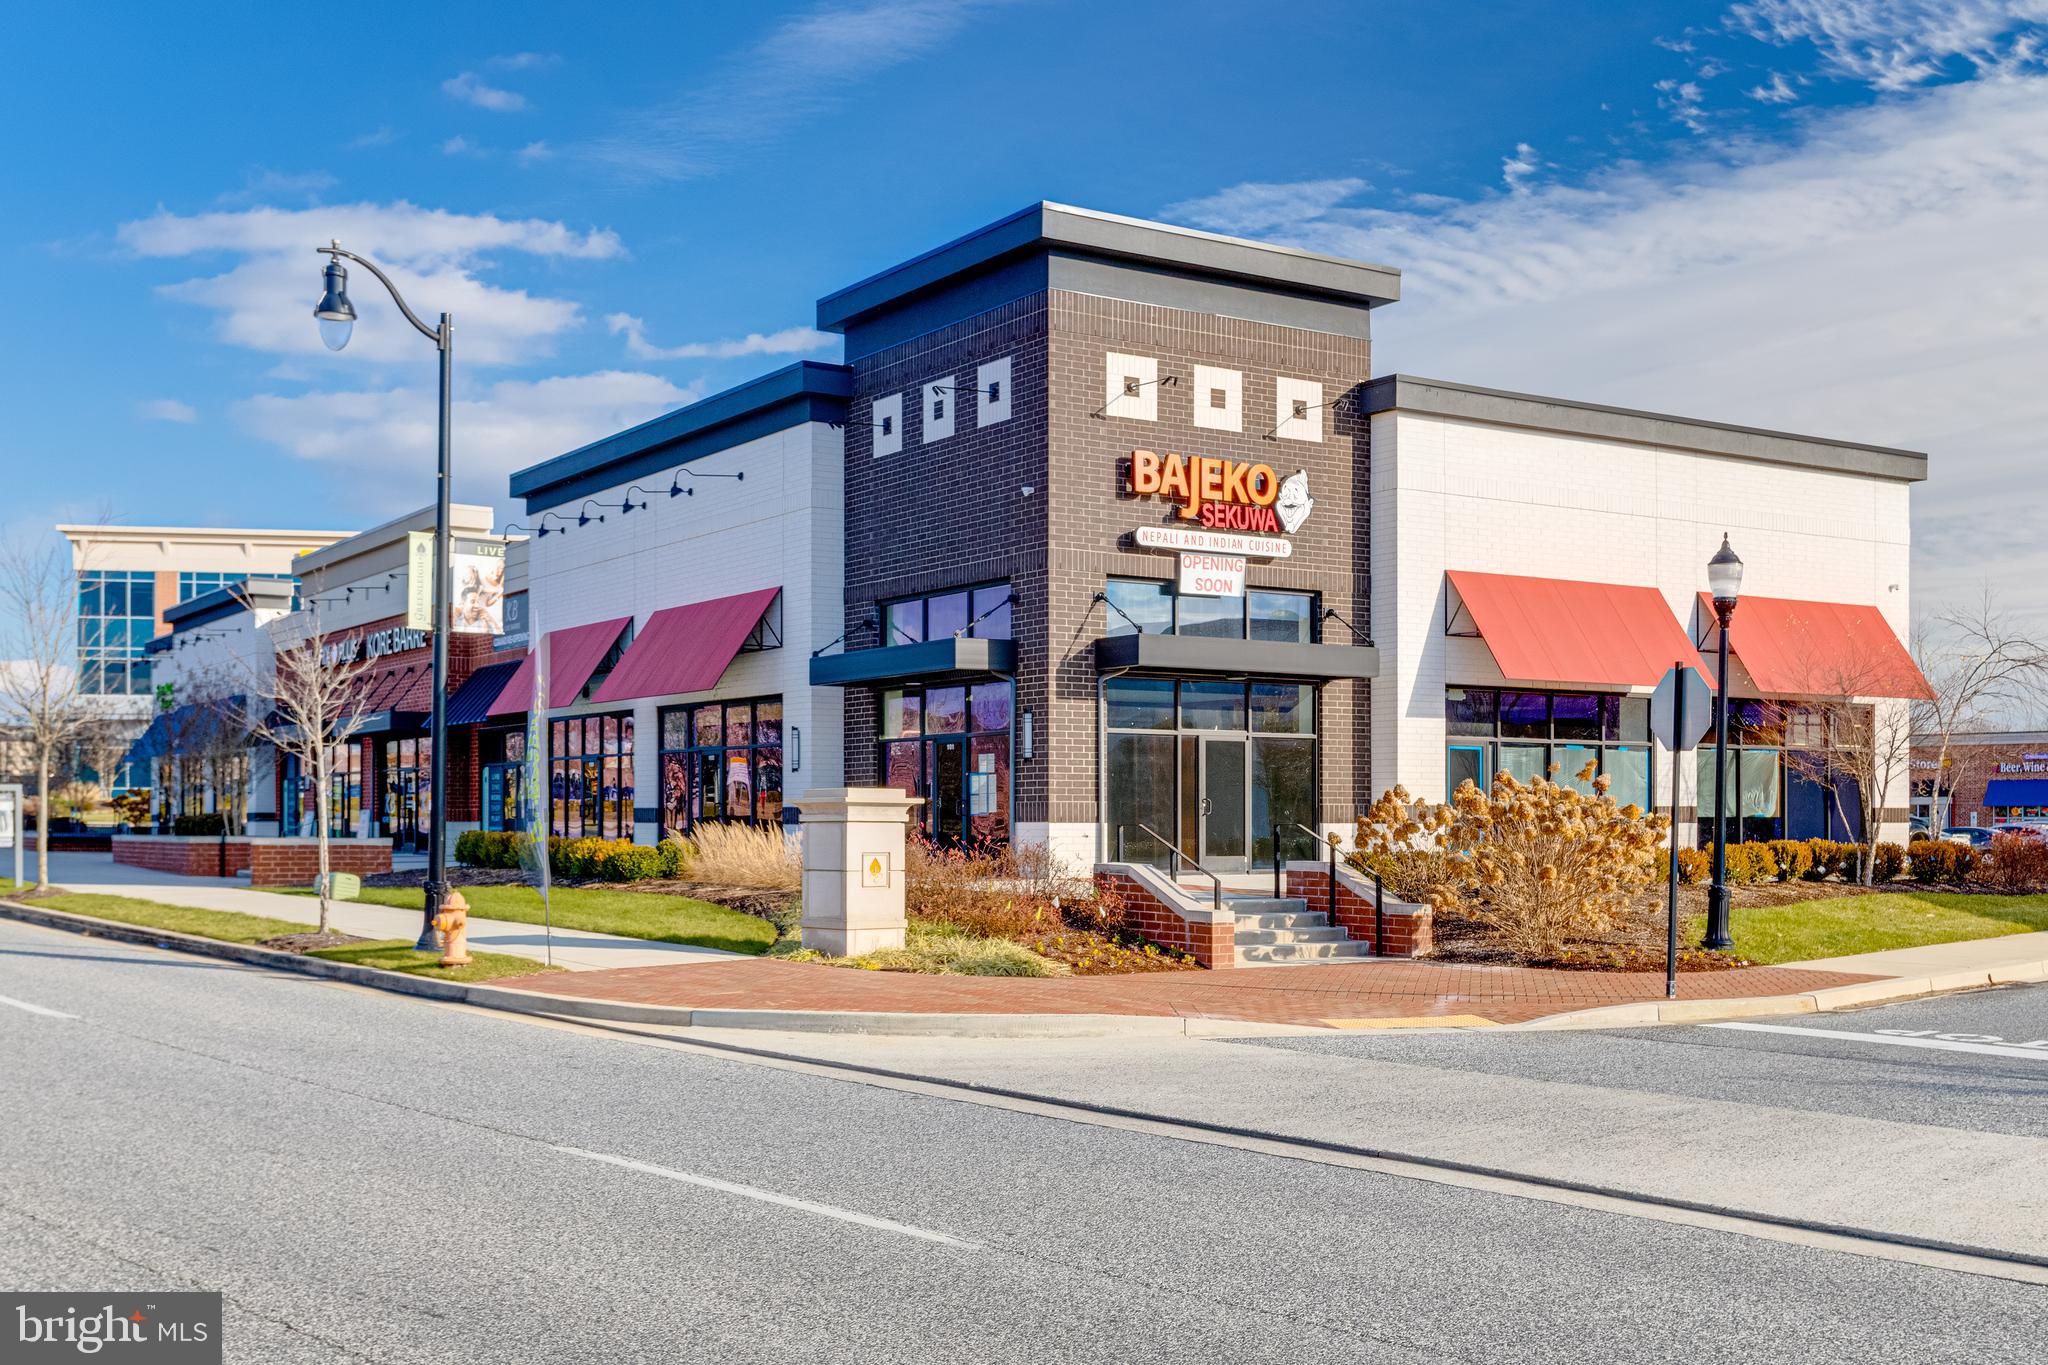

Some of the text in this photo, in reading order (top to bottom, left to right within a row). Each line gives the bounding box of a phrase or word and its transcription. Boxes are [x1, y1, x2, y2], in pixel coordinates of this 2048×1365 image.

[1132, 450, 1277, 518] BAJEKO
[1202, 504, 1278, 532] SEKUWA
[477, 545, 504, 557] LIVE
[1142, 530, 1287, 554] NEPALI AND INDIAN CUISINE
[1183, 555, 1243, 573] OPENING
[1195, 578, 1233, 593] SOON
[367, 627, 427, 657] KORE BARRE
